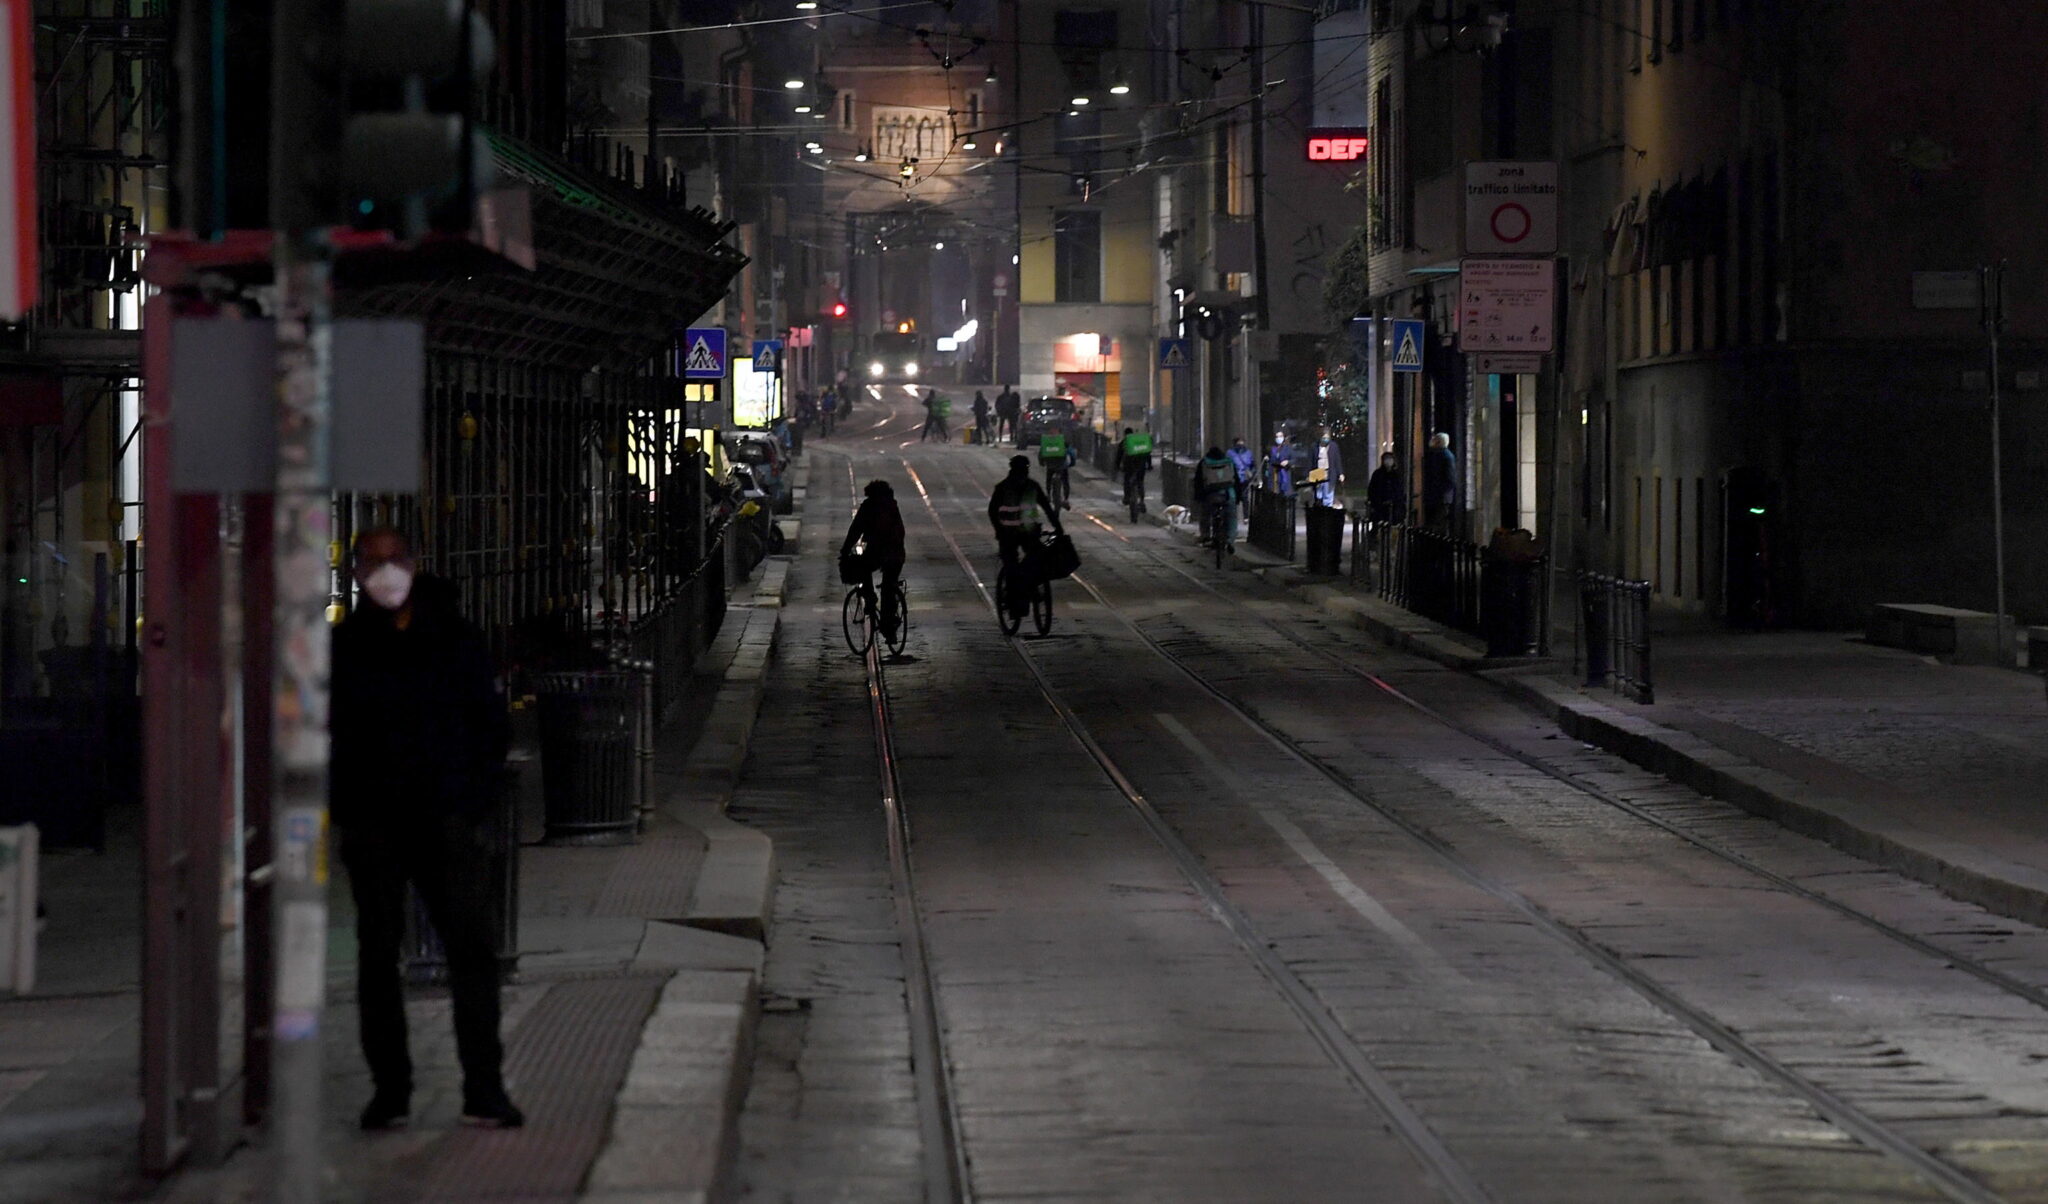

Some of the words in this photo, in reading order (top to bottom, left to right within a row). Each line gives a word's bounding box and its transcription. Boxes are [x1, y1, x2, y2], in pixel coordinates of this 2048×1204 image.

[1498, 167, 1524, 177] zona
[1468, 183, 1509, 194] traffico
[1513, 183, 1556, 194] limitato
